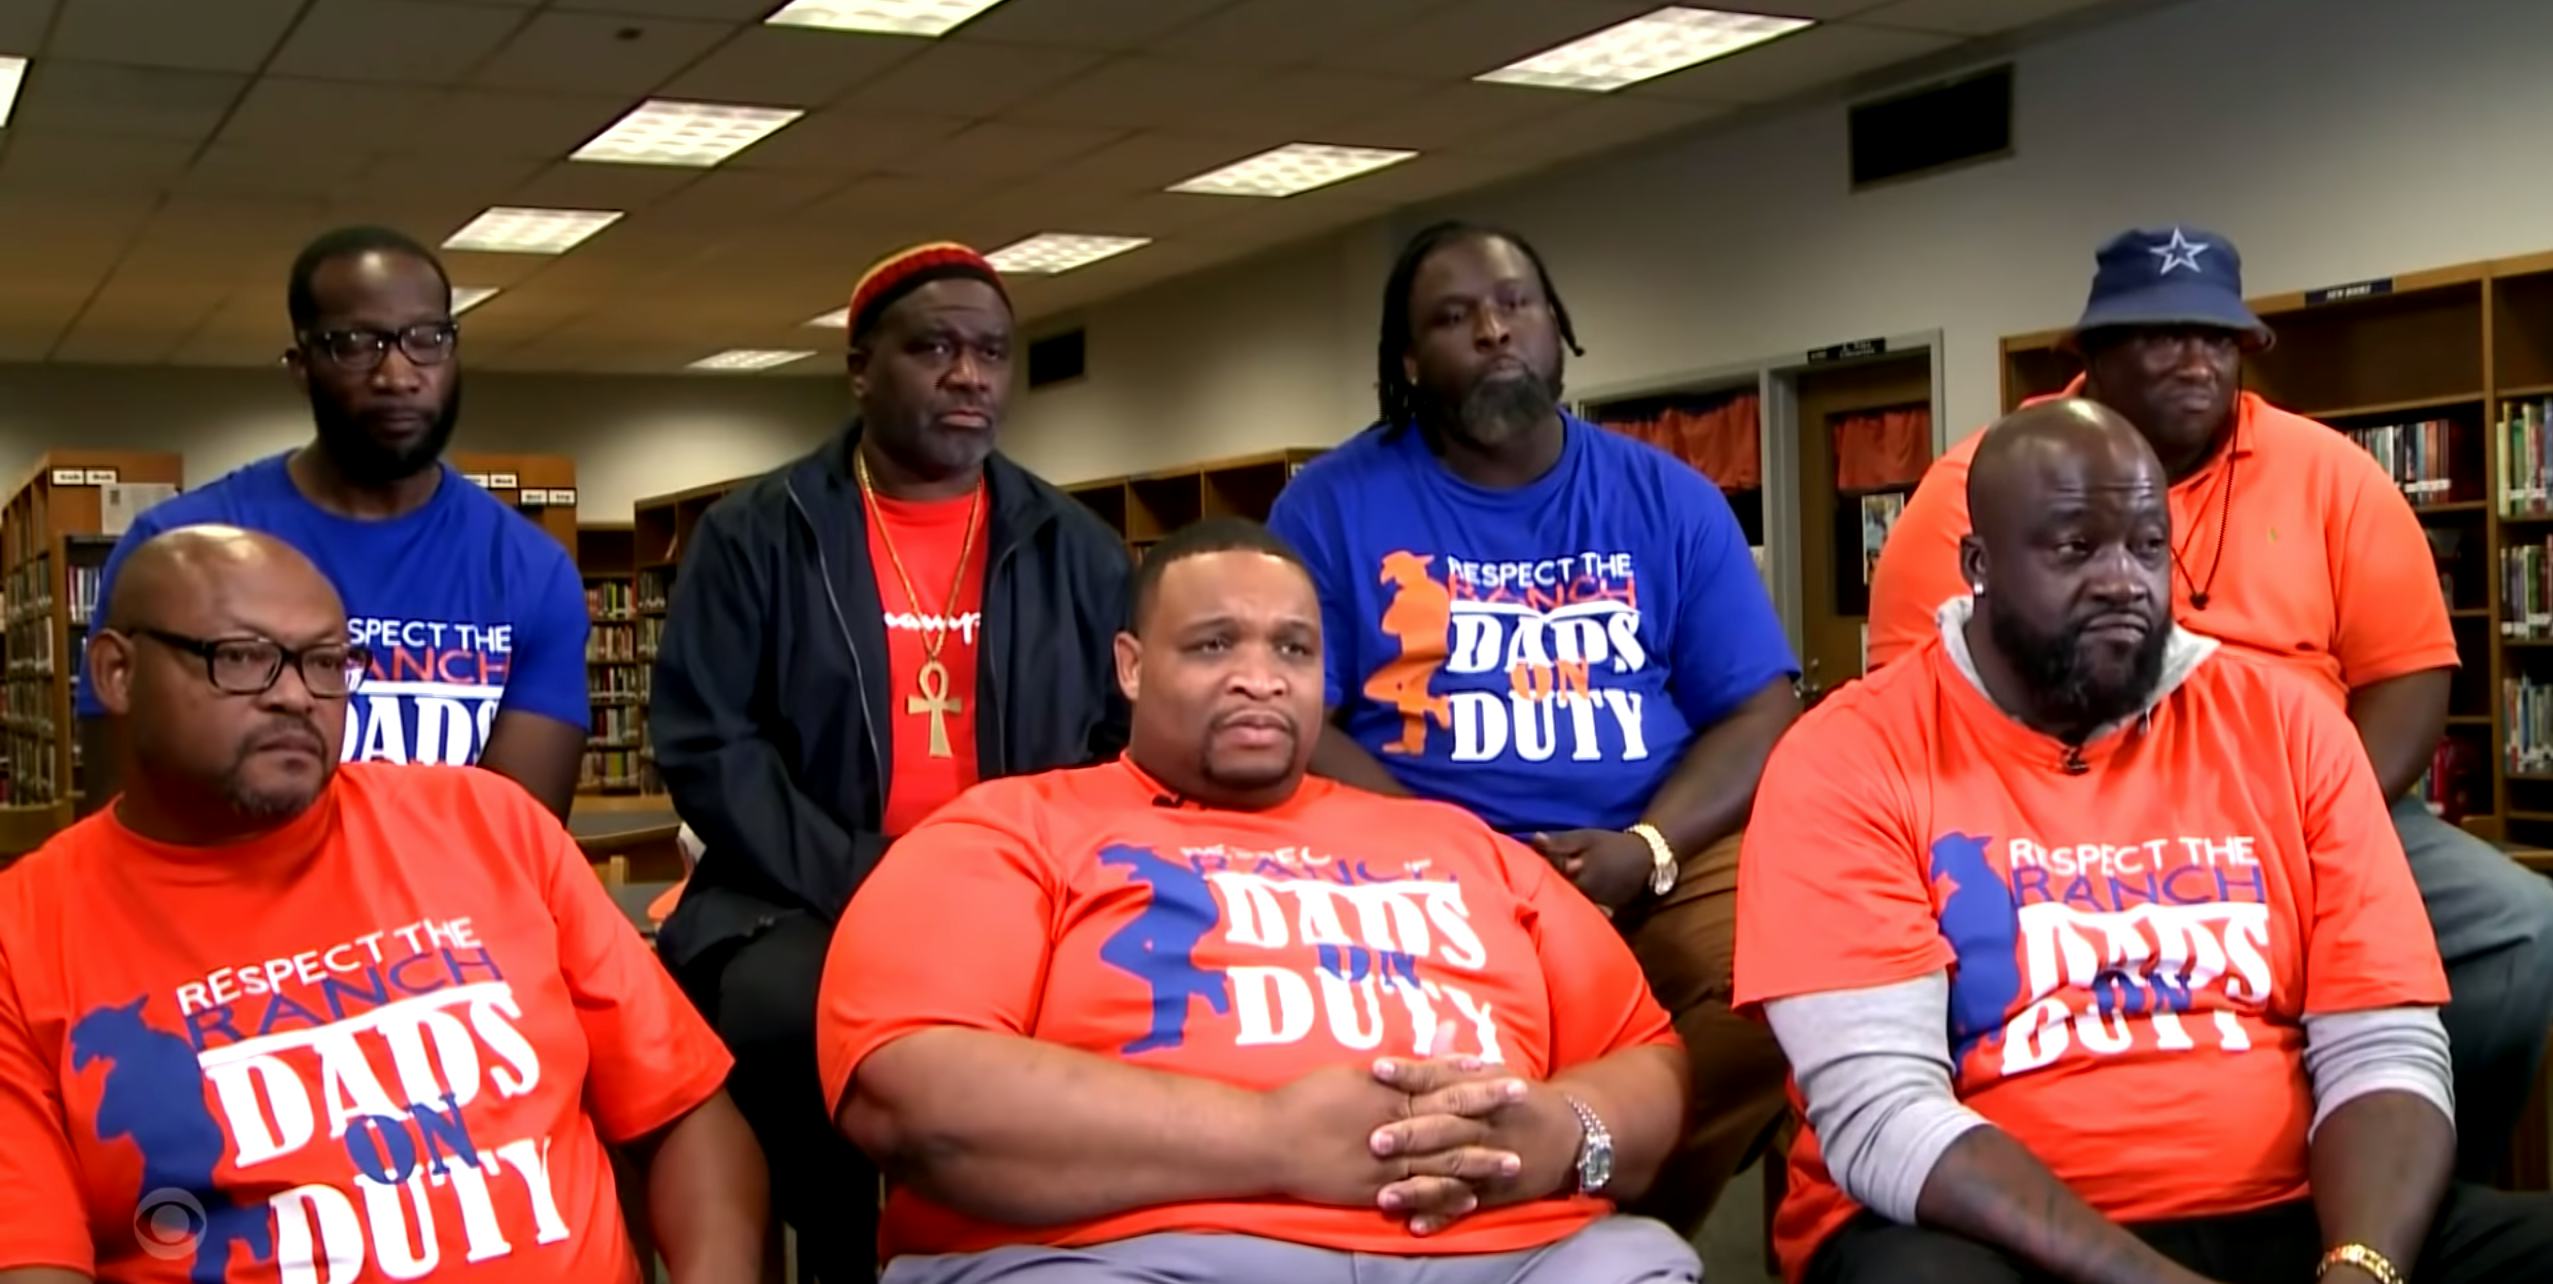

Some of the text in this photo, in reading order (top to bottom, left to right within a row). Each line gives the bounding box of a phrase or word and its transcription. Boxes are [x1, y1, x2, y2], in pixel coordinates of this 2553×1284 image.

[1447, 552, 1634, 588] RESPECT THE
[454, 625, 512, 653] THE
[1446, 612, 1646, 673] DADS
[1450, 689, 1648, 761] DUTY
[2011, 865, 2267, 911] RANCH
[2178, 837, 2260, 866] THE
[176, 916, 481, 1016] RESPECT THE
[1216, 876, 1486, 970] DADS
[2018, 908, 2272, 1002] DADS
[185, 947, 503, 1052] RANCH
[1226, 966, 1505, 1064] DUTY
[206, 1000, 540, 1168] DADS
[344, 1093, 478, 1185] ON
[269, 1136, 570, 1284] DUTY
